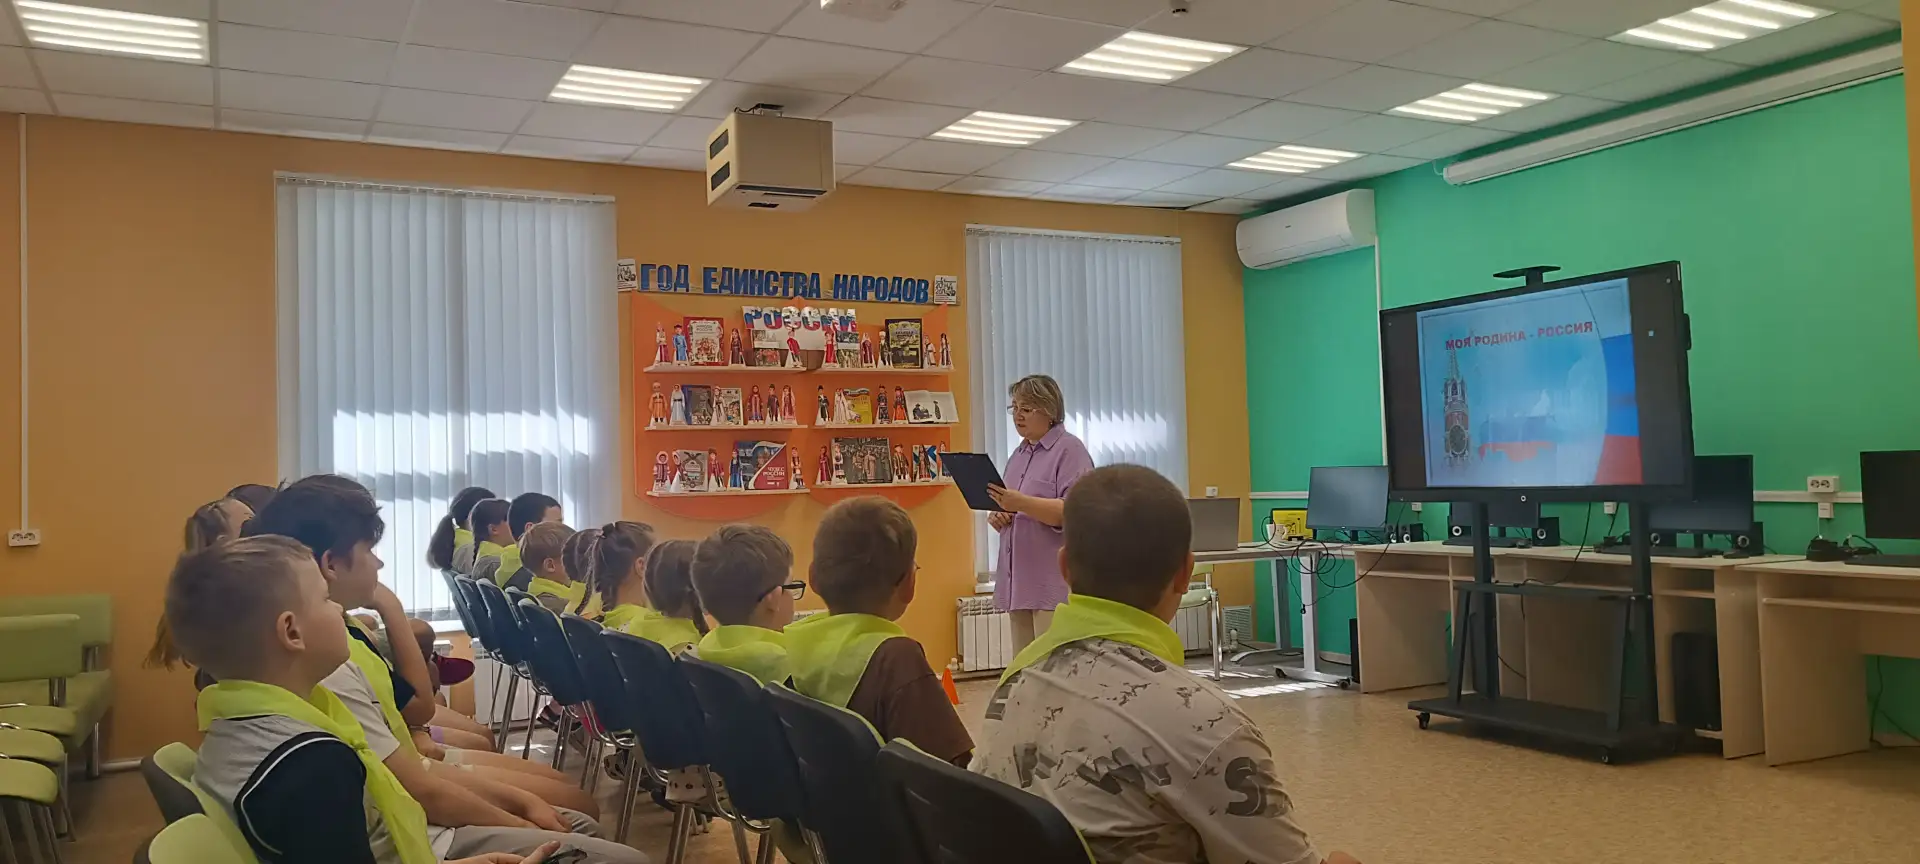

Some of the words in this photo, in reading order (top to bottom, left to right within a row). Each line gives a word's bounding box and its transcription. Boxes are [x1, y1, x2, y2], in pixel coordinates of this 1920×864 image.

[640, 264, 689, 292] ГОД
[703, 267, 821, 299] ЕДИНСТВА
[833, 273, 930, 303] НАРОДОВ
[742, 306, 857, 332] РОССИИ
[1445, 336, 1472, 351] МОЯ
[1474, 330, 1527, 346] РОДИНА
[1537, 321, 1593, 338] РОССИЯ
